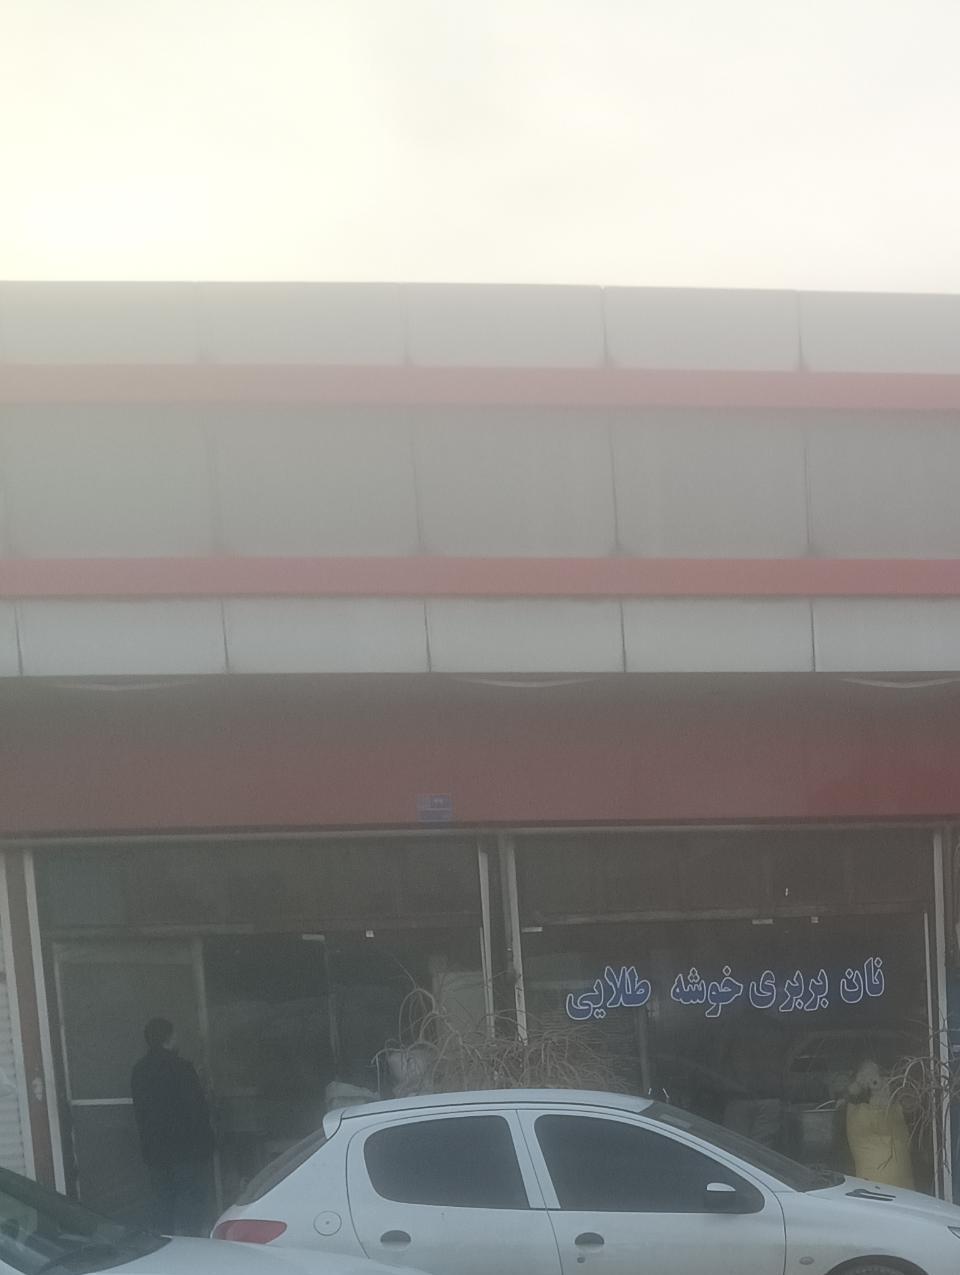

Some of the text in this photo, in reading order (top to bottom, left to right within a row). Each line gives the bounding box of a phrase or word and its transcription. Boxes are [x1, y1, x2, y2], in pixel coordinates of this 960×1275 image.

[566, 957, 886, 1021] نان بربری خوشه طلایی
